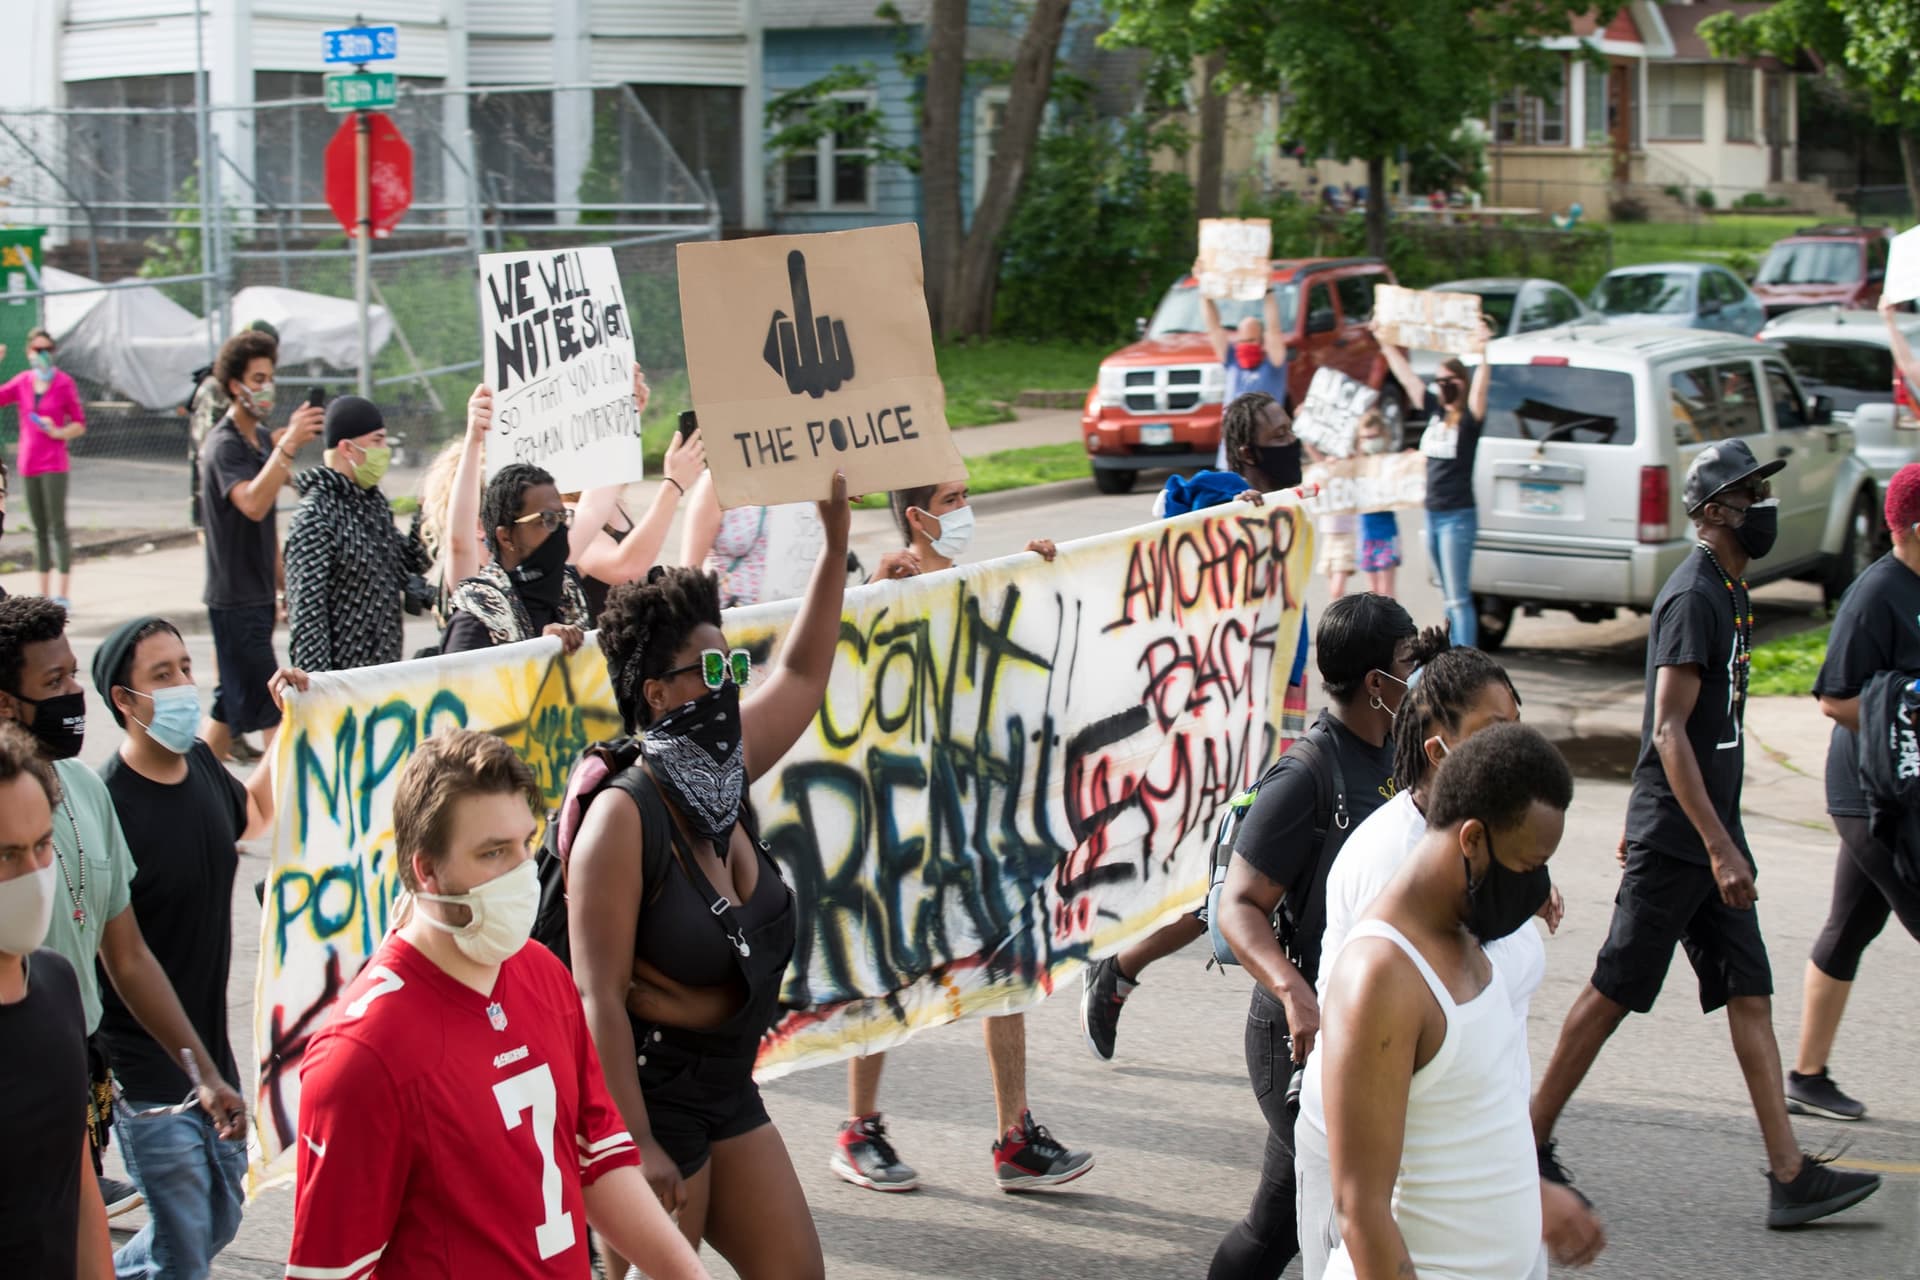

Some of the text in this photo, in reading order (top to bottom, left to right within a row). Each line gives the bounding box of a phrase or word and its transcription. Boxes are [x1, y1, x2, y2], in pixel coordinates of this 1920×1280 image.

[322, 35, 334, 58] E
[327, 80, 340, 103] S
[488, 251, 590, 322] WE WILL
[495, 308, 550, 392] NOT
[552, 305, 582, 362] BE
[500, 352, 628, 435] SO THAT YOU CAN
[734, 405, 919, 467] THE POLICE
[1137, 613, 1280, 734] BLACK
[345, 965, 404, 1017] 7
[492, 1063, 576, 1261] 7
